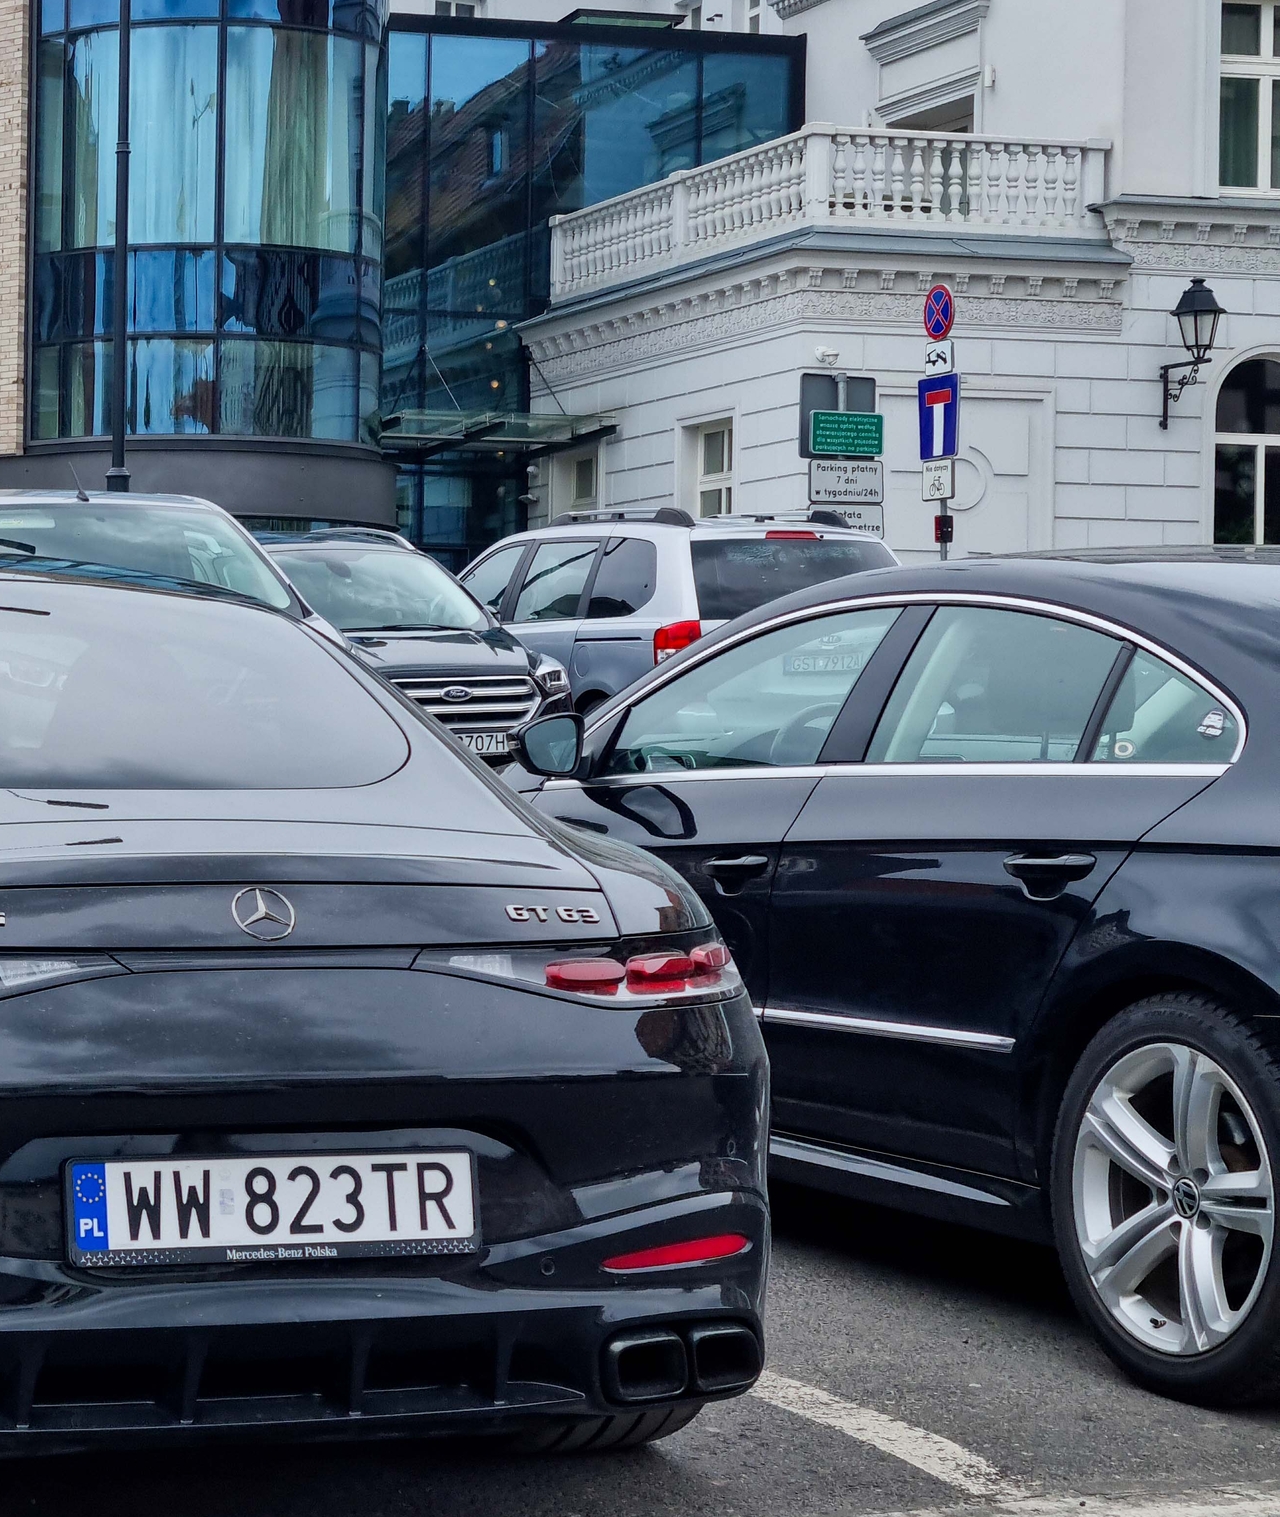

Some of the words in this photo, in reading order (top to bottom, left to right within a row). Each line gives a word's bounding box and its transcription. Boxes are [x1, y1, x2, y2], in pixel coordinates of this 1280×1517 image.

[816, 464, 848, 474] Parking
[851, 464, 878, 475] płatny
[925, 465, 933, 473] Nie
[933, 464, 949, 474] dotyczy
[836, 476, 841, 484] 7
[844, 476, 858, 484] dni
[824, 488, 879, 498] tygodniu/24h
[792, 657, 818, 671] GST
[448, 689, 466, 697] Ford
[457, 734, 505, 751] 707H
[505, 905, 549, 923] GT
[555, 906, 601, 924] 63
[79, 1218, 104, 1238] PL
[123, 1169, 211, 1241] WW
[244, 1162, 457, 1236] 823TR
[226, 1247, 303, 1260] Mercedes-Benz
[304, 1246, 338, 1258] Polska
